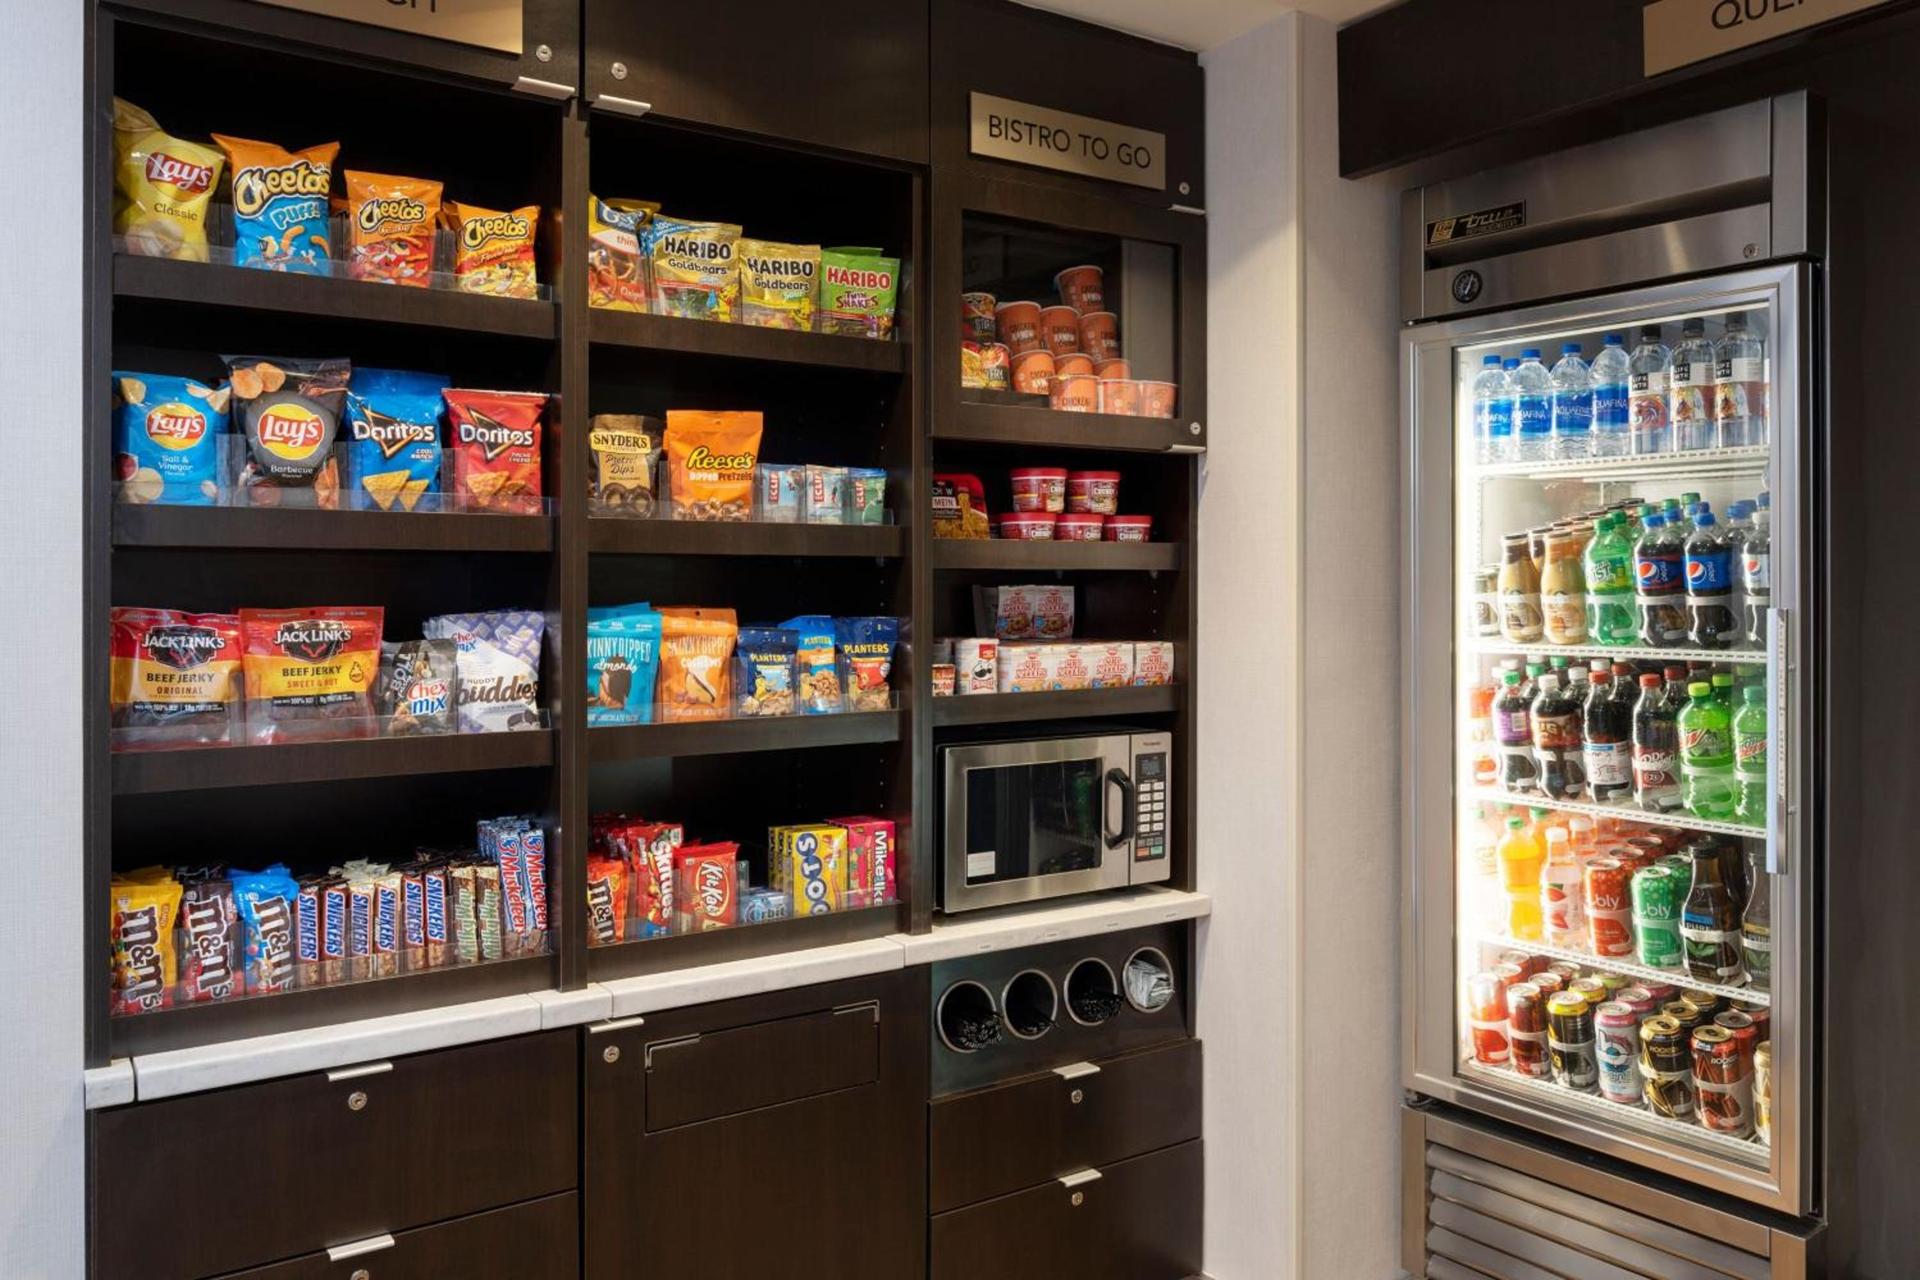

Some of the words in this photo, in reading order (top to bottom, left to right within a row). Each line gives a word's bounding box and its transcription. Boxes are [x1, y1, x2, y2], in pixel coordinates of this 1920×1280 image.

[988, 115, 1071, 153] BISTRO
[1077, 132, 1109, 161] TO
[1117, 143, 1152, 170] GO
[233, 160, 331, 217] Cheetos
[154, 203, 198, 221] Classic
[361, 199, 426, 232] Cheetos
[462, 214, 529, 250] Cheetos
[664, 236, 732, 260] HARIBO
[668, 259, 728, 275] Goldbears
[748, 258, 814, 281] HARIBO
[826, 266, 892, 290] HARIBO
[754, 278, 810, 292] Goldbears
[151, 412, 203, 438] Lay's
[263, 414, 321, 448] Lay's
[352, 421, 435, 441] Doritos
[460, 424, 533, 446] Doritos
[593, 433, 648, 450] SNYDER'S
[158, 461, 193, 474] Vinegar
[687, 445, 756, 470] Reese's
[270, 464, 314, 476] Barbecue
[141, 634, 180, 650] JACK
[178, 634, 225, 651] LINK'S
[273, 629, 312, 645] JACK
[312, 627, 353, 643] LINK'S
[588, 636, 651, 663] KINNYDIPPED
[750, 653, 787, 663] PLANTERS
[843, 643, 890, 654] PLANTERS
[146, 671, 176, 684] BEEF
[177, 672, 215, 684] JERKY
[281, 667, 308, 678] BEEF
[308, 665, 342, 678] JERKY
[156, 685, 203, 695] ORIGINAL
[407, 681, 449, 700] Chex
[457, 675, 540, 705] buddies
[413, 697, 446, 715] mix
[524, 837, 543, 855] 3
[874, 830, 888, 877] Mike
[405, 882, 422, 943] SNICKERS
[427, 875, 445, 939] SNICKERS
[300, 894, 317, 959] SNICKERS
[327, 891, 343, 955] SNICKERS
[351, 895, 369, 955] SNICKERS
[379, 889, 395, 950] SNICKERS
